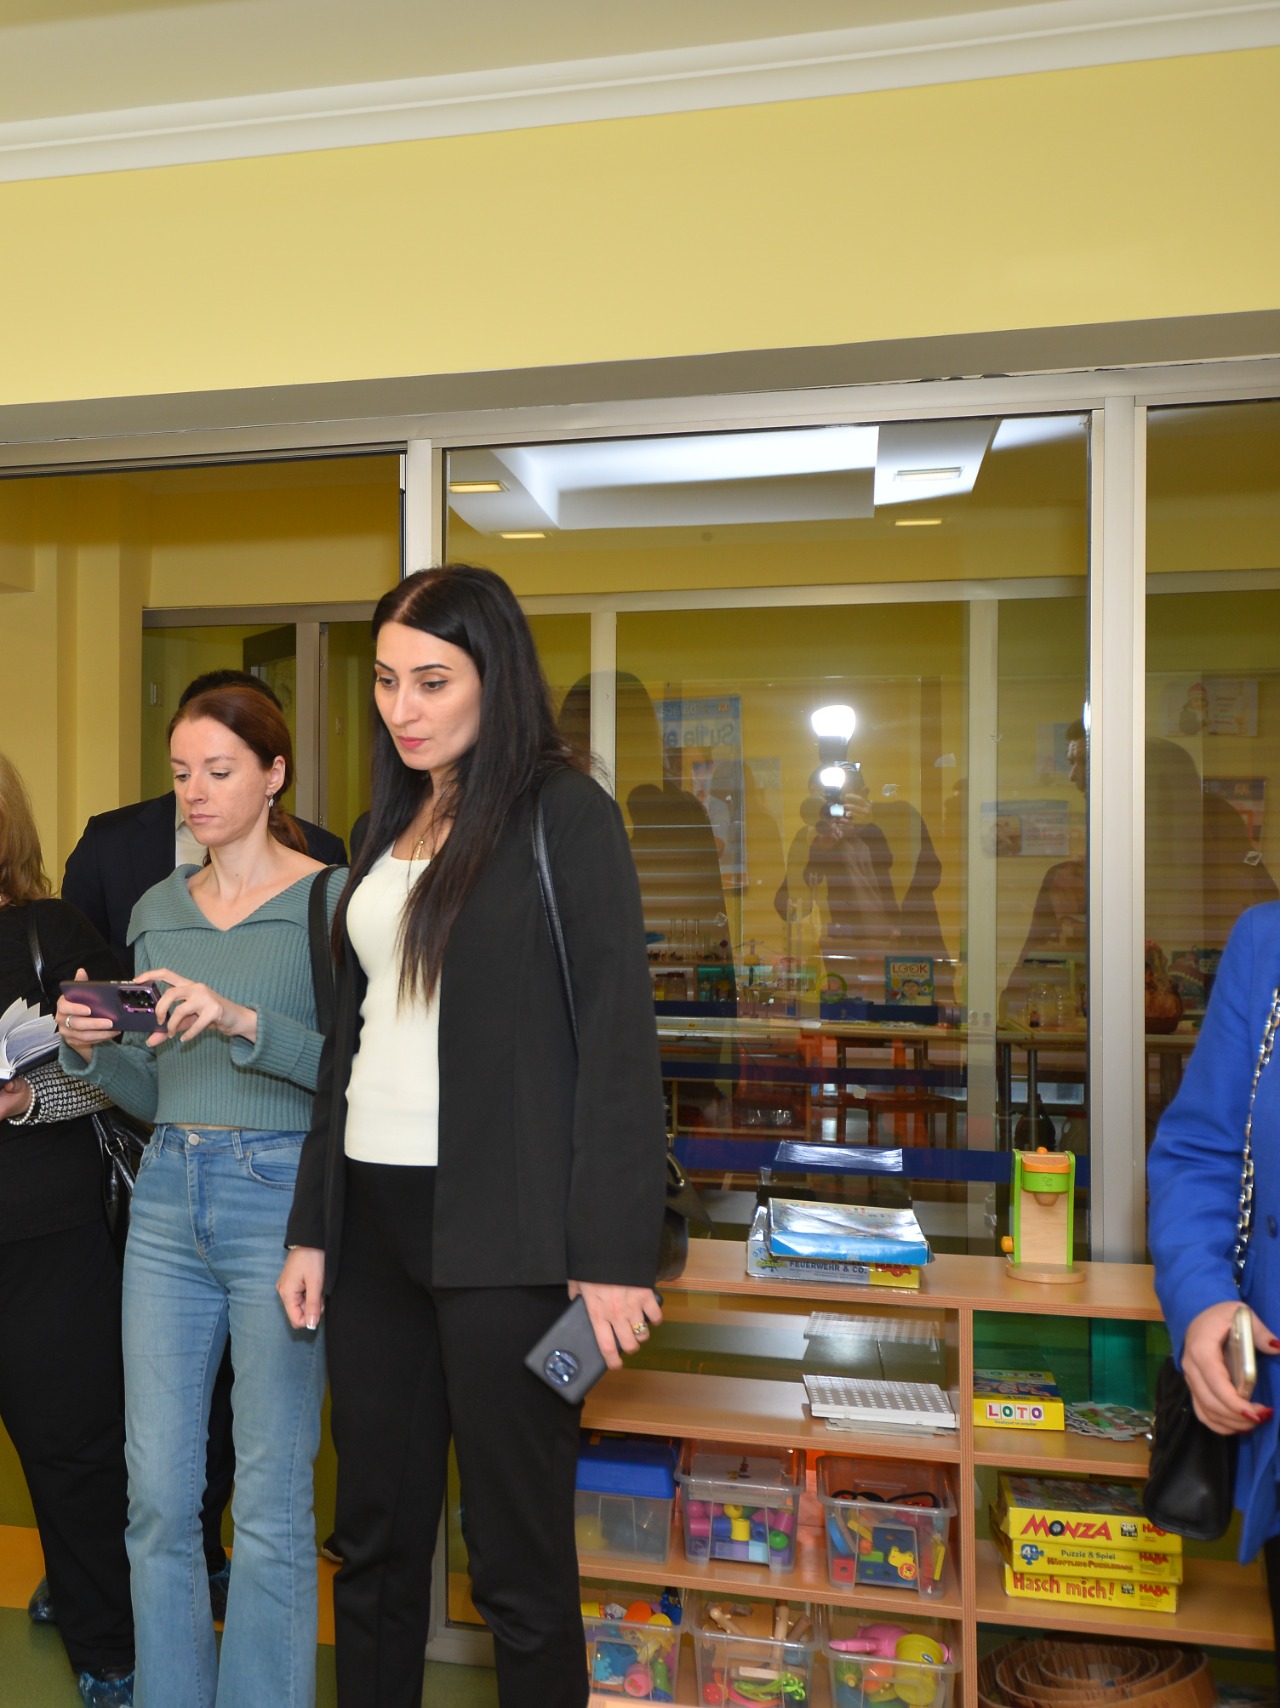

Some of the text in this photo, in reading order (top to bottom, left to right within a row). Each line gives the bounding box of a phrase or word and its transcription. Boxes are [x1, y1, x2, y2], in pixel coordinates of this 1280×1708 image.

[892, 964, 928, 974] LOOK
[789, 1261, 840, 1272] FEUERWEHR
[842, 1263, 850, 1272] &
[852, 1265, 868, 1275] CO.
[988, 1404, 1042, 1419] LOTO
[1021, 1514, 1112, 1541] MONZA
[1061, 1549, 1116, 1561] Puzzle & Spiel
[1013, 1572, 1061, 1594] Hasch
[1066, 1577, 1115, 1601] mich!
[1139, 1583, 1170, 1597] HABA
